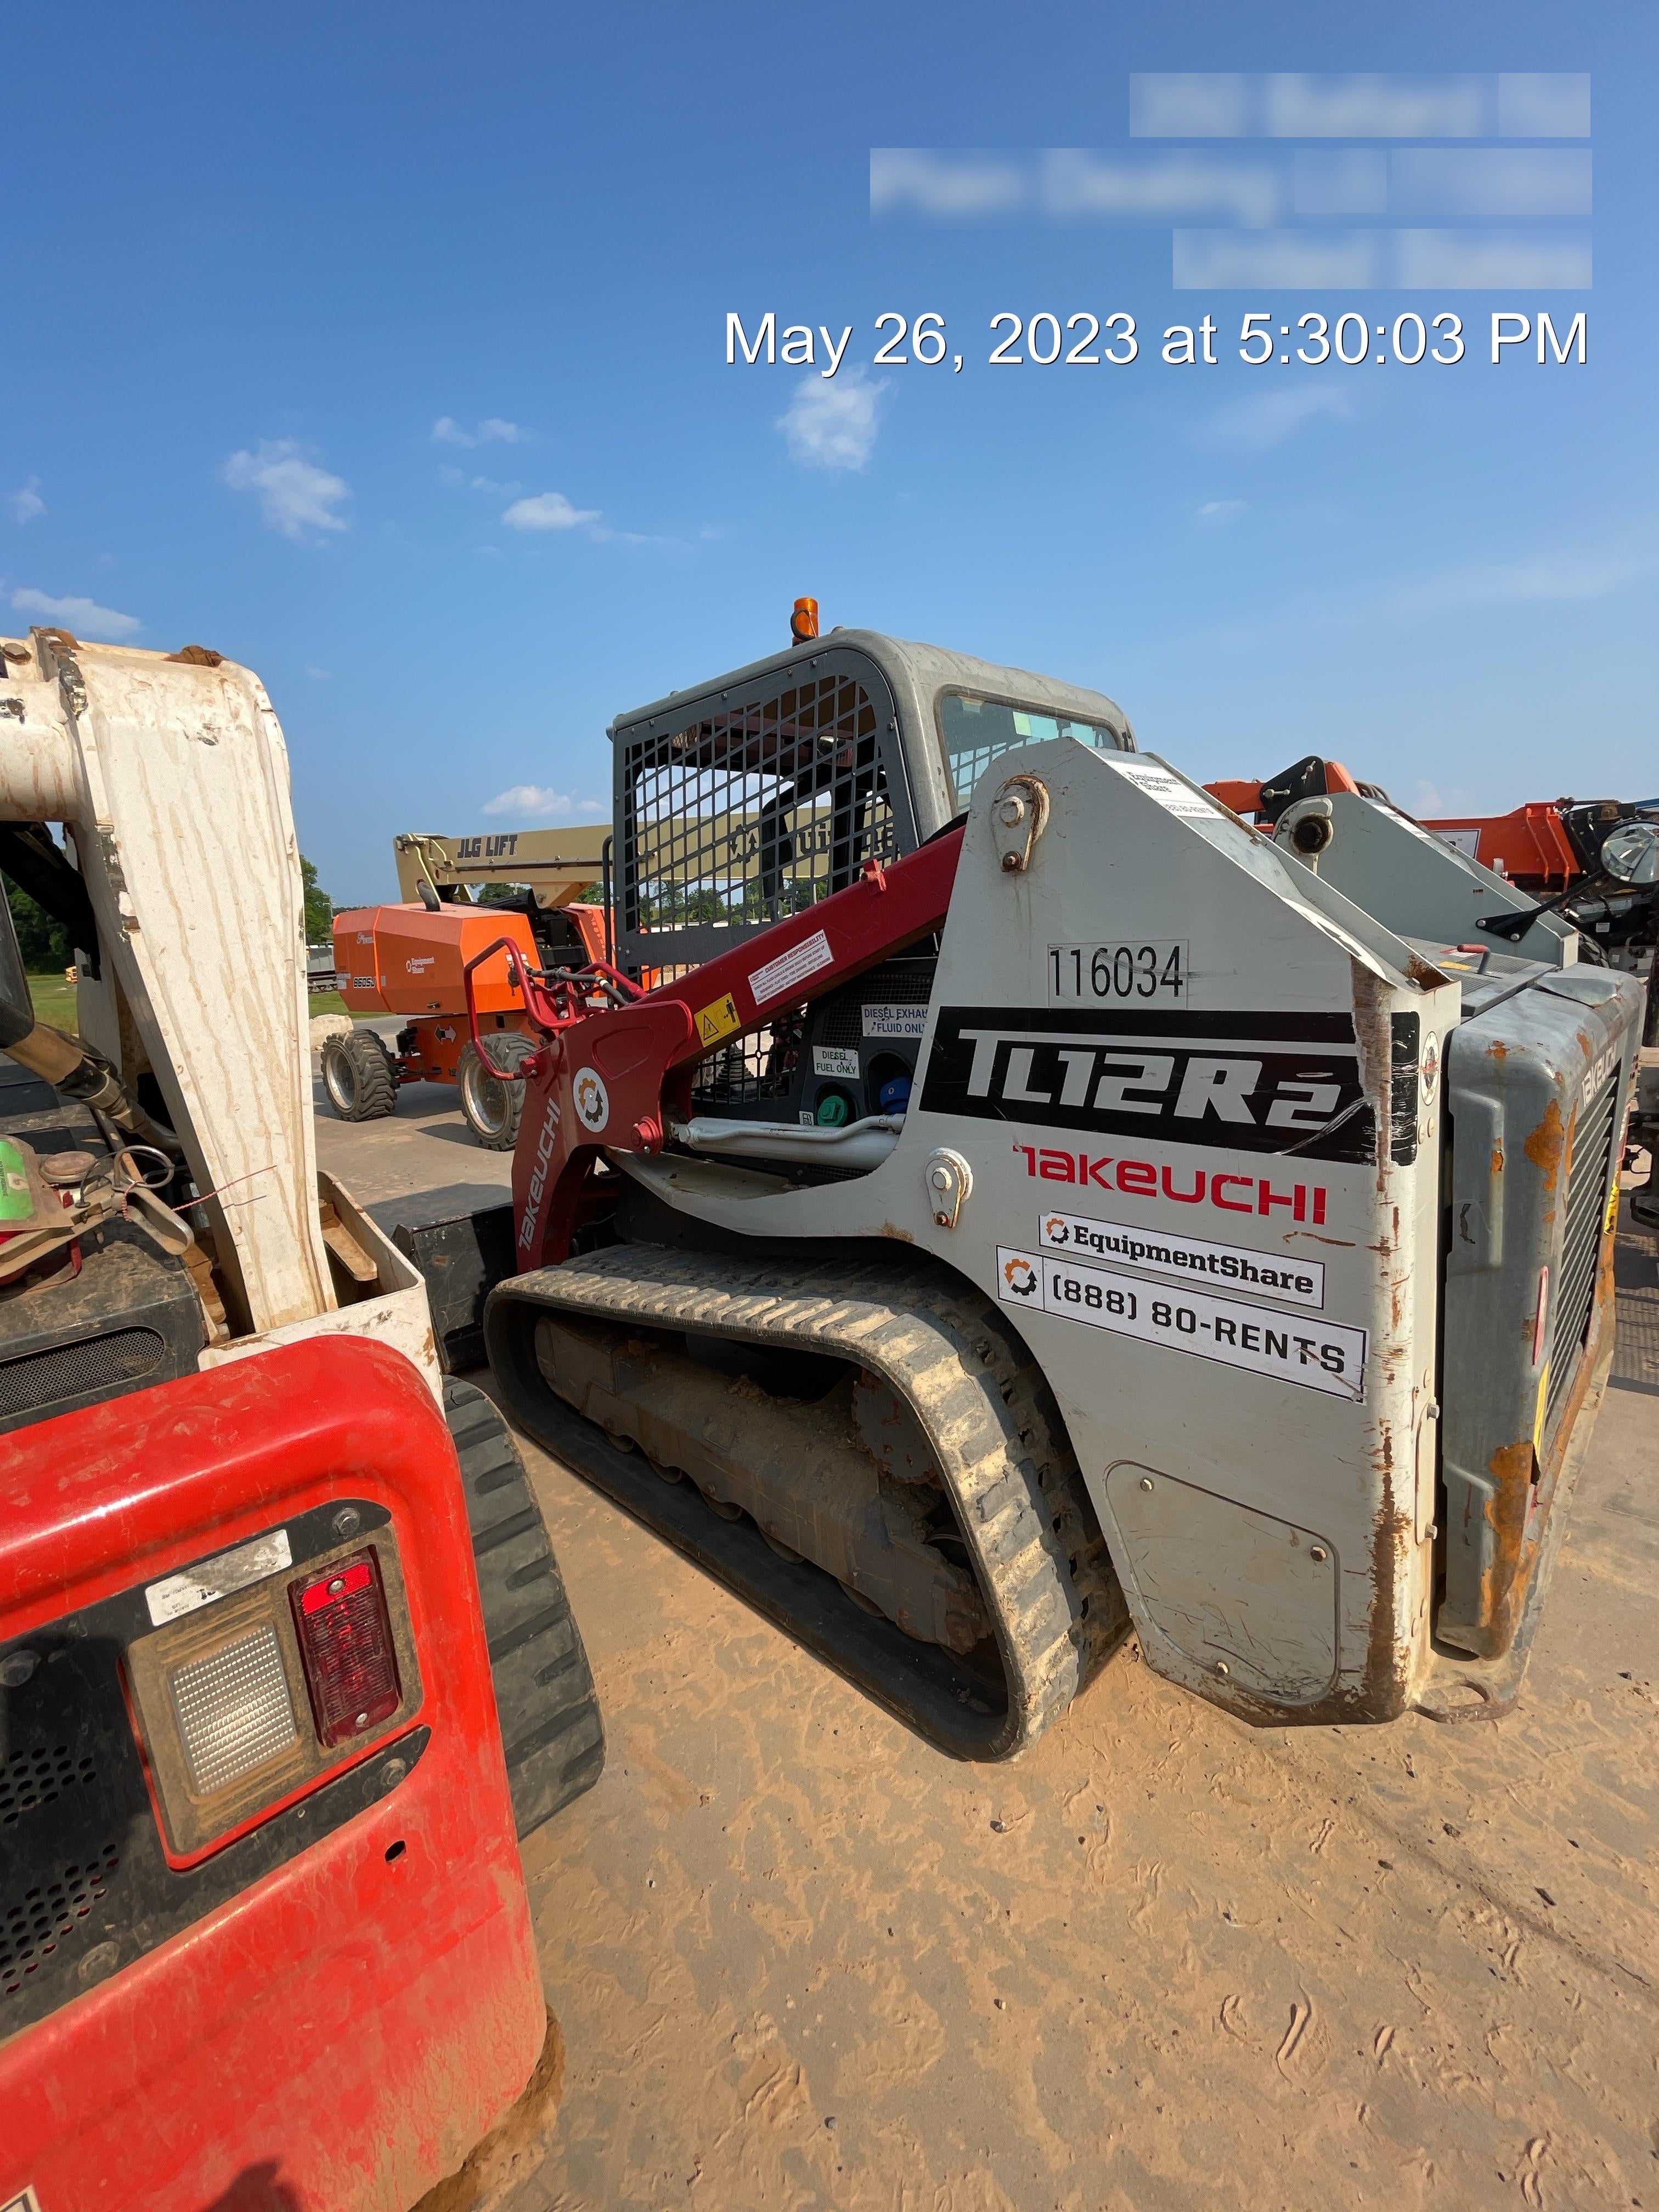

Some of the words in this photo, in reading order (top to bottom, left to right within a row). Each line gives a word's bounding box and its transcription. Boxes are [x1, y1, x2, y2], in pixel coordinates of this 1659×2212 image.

[457, 837, 482, 859] JLG
[485, 834, 518, 857] LIFT
[765, 956, 788, 973] CUSTOMER
[788, 933, 824, 959] RESPONSIBILITY
[1049, 945, 1184, 998] 116034
[864, 1008, 894, 1018] DIESEL
[896, 1008, 928, 1019] EXHAU
[877, 1023, 902, 1032] FLUID
[816, 1063, 835, 1072] FUEL
[836, 1064, 856, 1074] ONLY
[822, 1051, 849, 1060] DIESEL
[958, 1029, 1356, 1131] TL12R2
[1073, 1224, 1314, 1295] EquipmentShare
[1052, 1274, 1137, 1321] (888)
[1151, 1300, 1345, 1374] 80-RENTS
